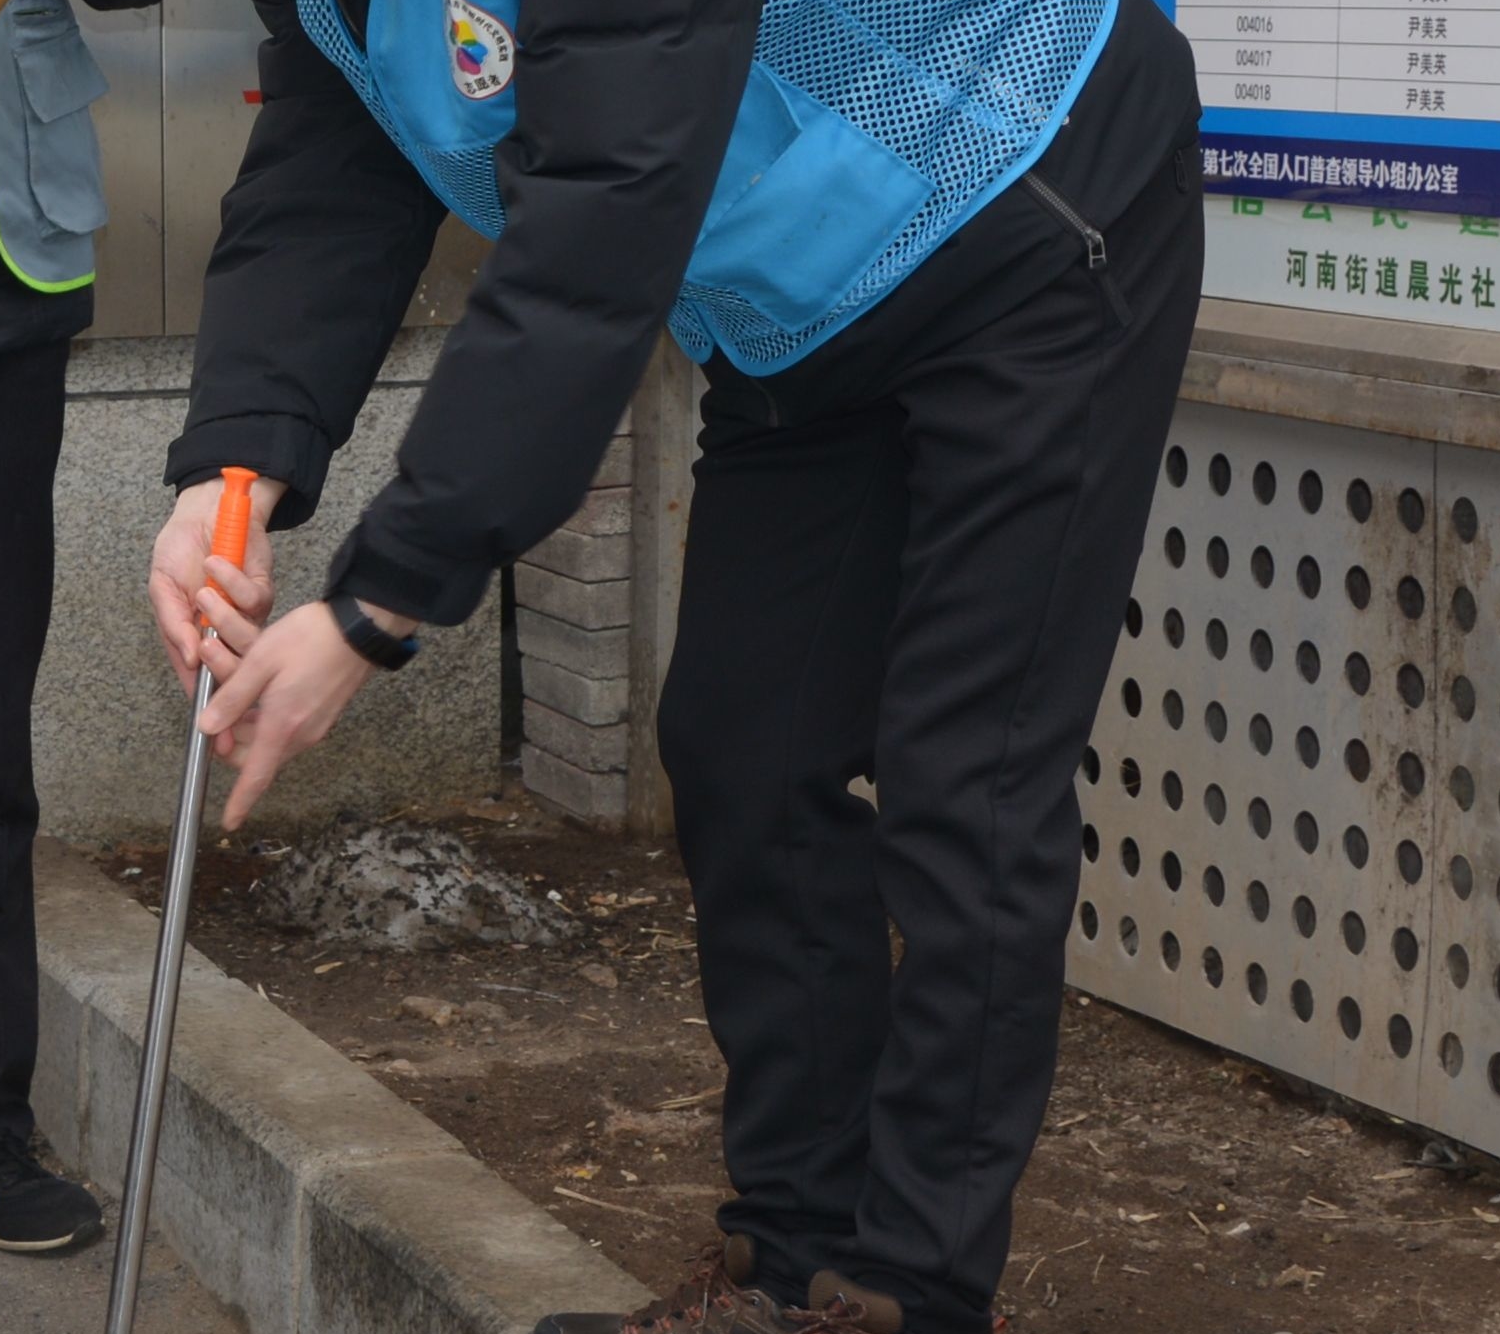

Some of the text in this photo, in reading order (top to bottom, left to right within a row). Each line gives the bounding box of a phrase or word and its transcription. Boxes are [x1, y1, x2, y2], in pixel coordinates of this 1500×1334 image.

[1236, 15, 1274, 34] 004016
[1407, 15, 1448, 39] 尹美英
[1235, 49, 1273, 67] 004017
[1406, 51, 1447, 75] 尹美英
[1235, 82, 1271, 101] 004018
[1405, 87, 1446, 110] 尹美英
